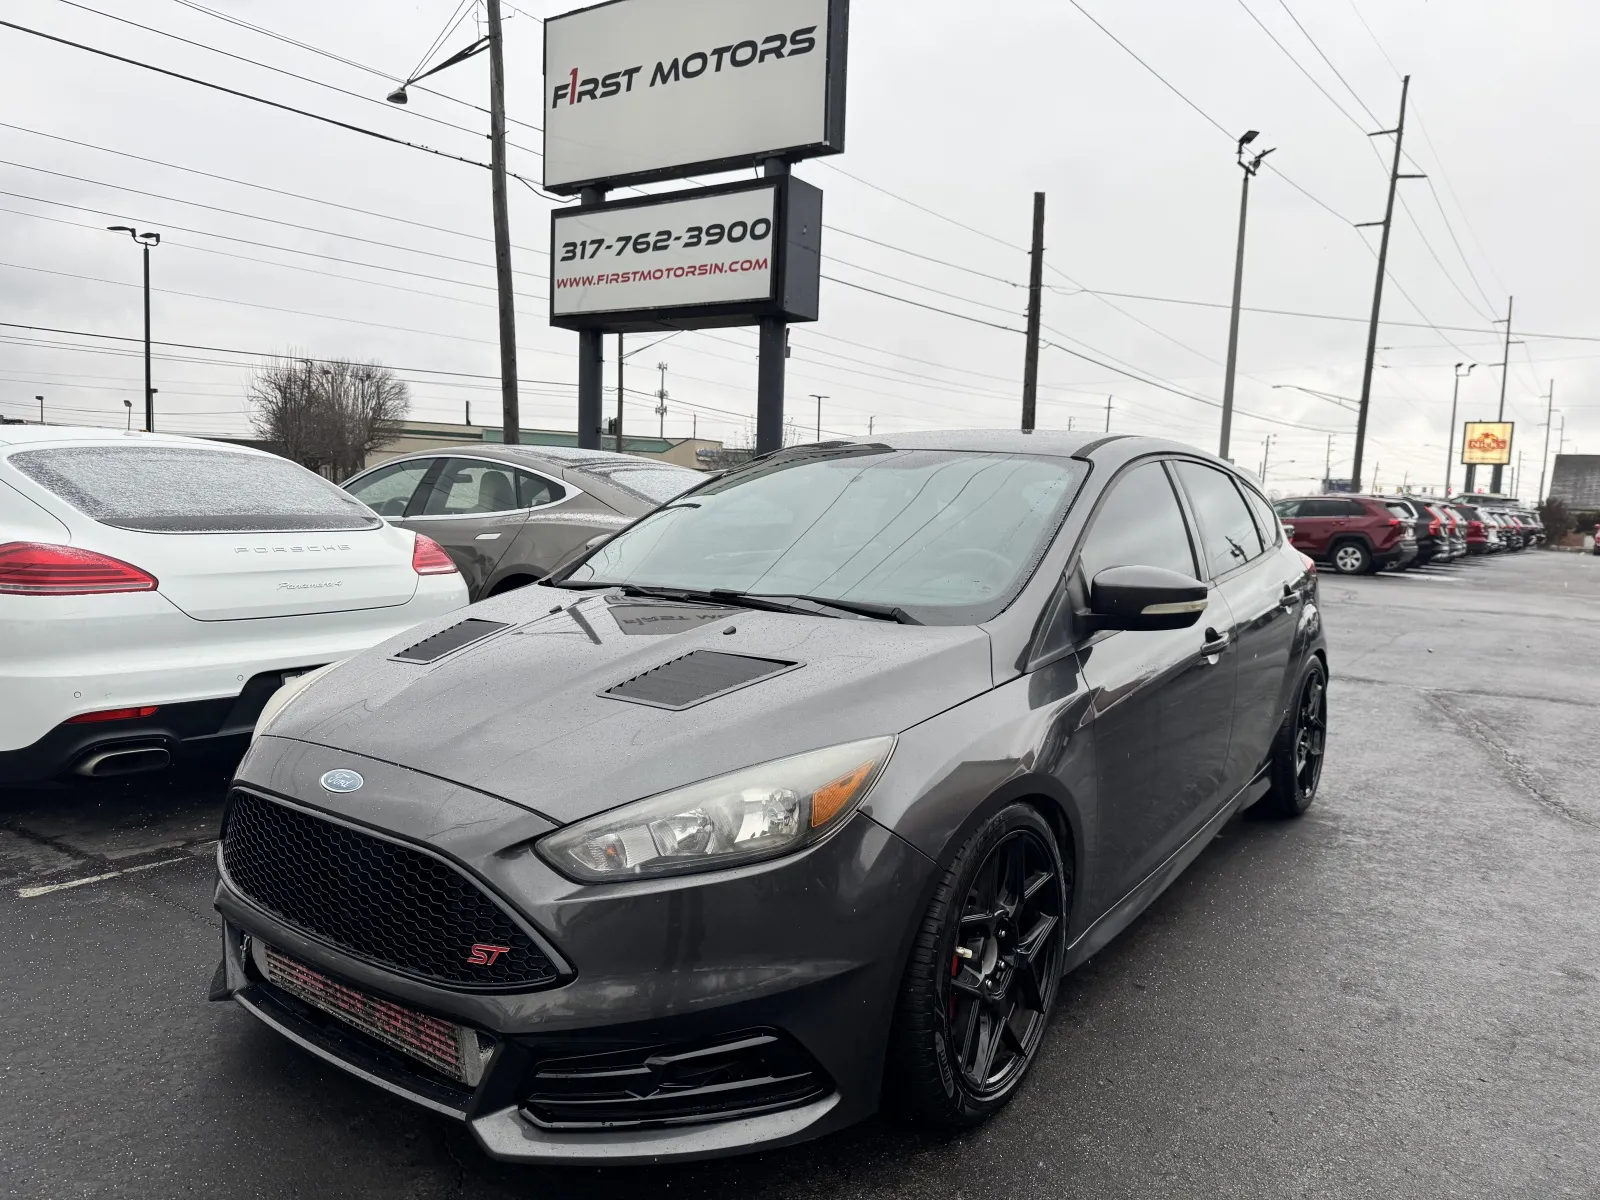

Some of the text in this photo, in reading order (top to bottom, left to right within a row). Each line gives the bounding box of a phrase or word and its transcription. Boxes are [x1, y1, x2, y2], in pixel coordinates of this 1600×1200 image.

[649, 25, 817, 87] MOTORS
[560, 217, 771, 262] 317-762-3900
[556, 257, 768, 289] WWW.FIRSTMOTORSIN.COM
[234, 544, 351, 554] PORSCHE
[467, 944, 510, 965] ST
